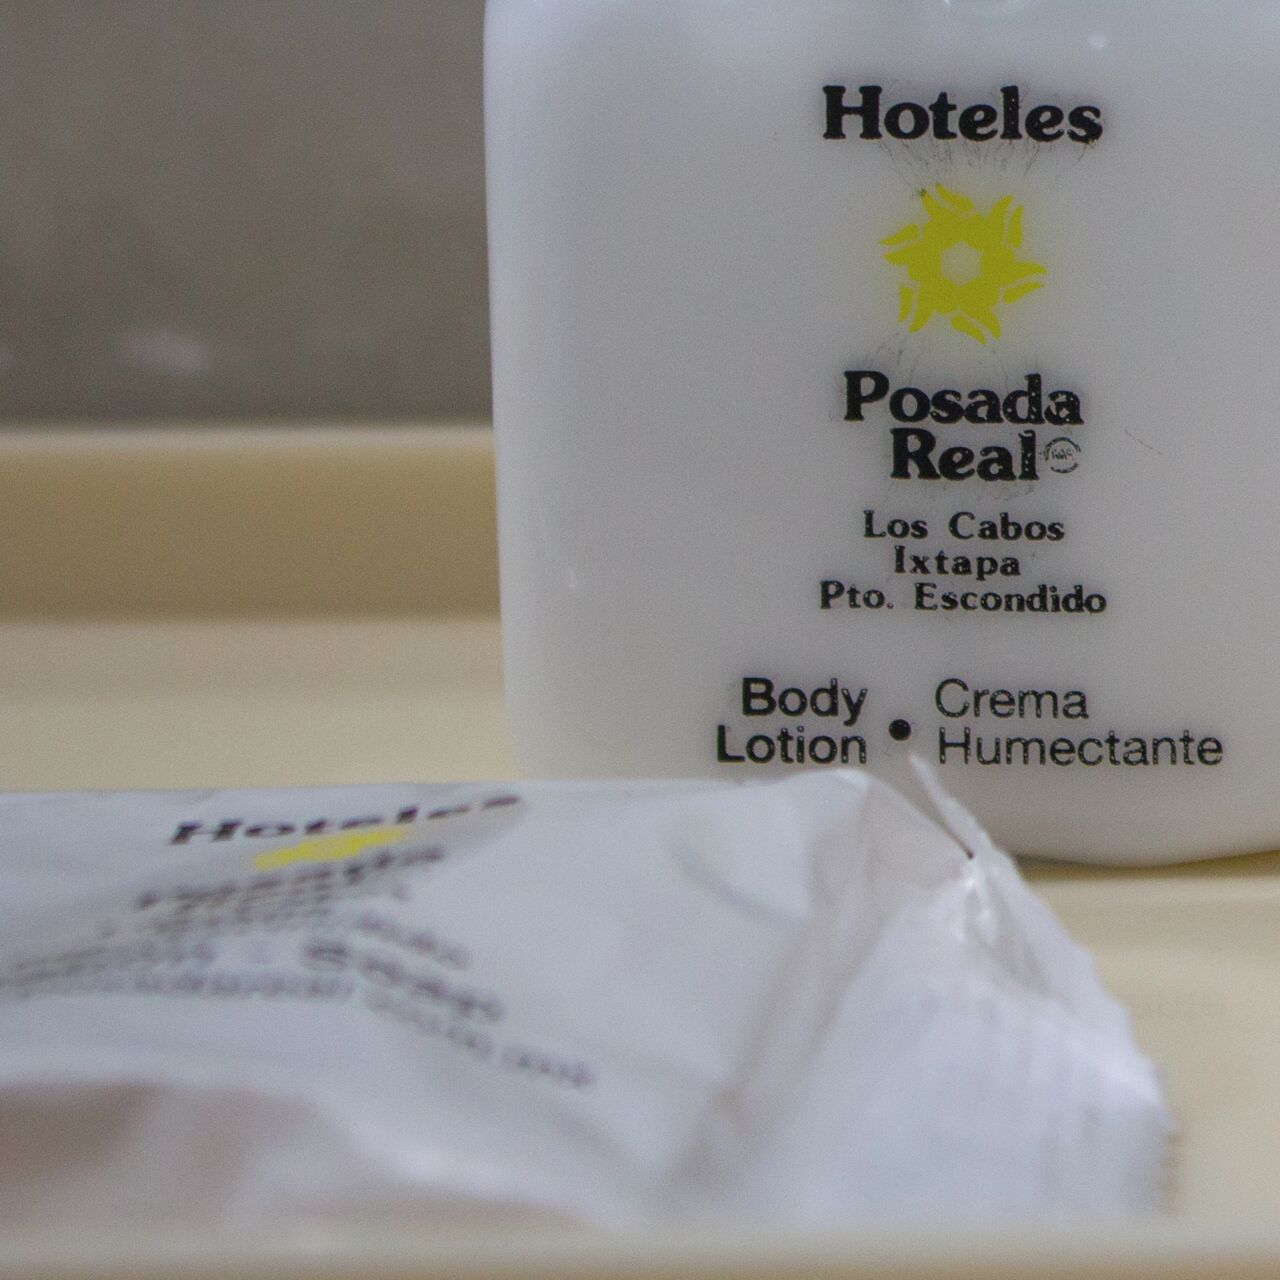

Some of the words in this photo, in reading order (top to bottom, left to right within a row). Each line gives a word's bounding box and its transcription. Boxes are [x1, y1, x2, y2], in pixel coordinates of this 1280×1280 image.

[822, 84, 1103, 144] Hoteles
[843, 369, 1084, 427] Posada
[889, 426, 1039, 482] Real
[863, 509, 929, 540] Los
[948, 510, 1065, 542] Cabos
[894, 544, 1022, 581] Ixtapa
[819, 579, 894, 611] Pto.
[915, 580, 1108, 614] Escondido
[741, 676, 867, 727] Body
[934, 677, 1090, 721] Crema
[716, 724, 868, 765] Lotion
[937, 725, 1224, 767] Humectante
